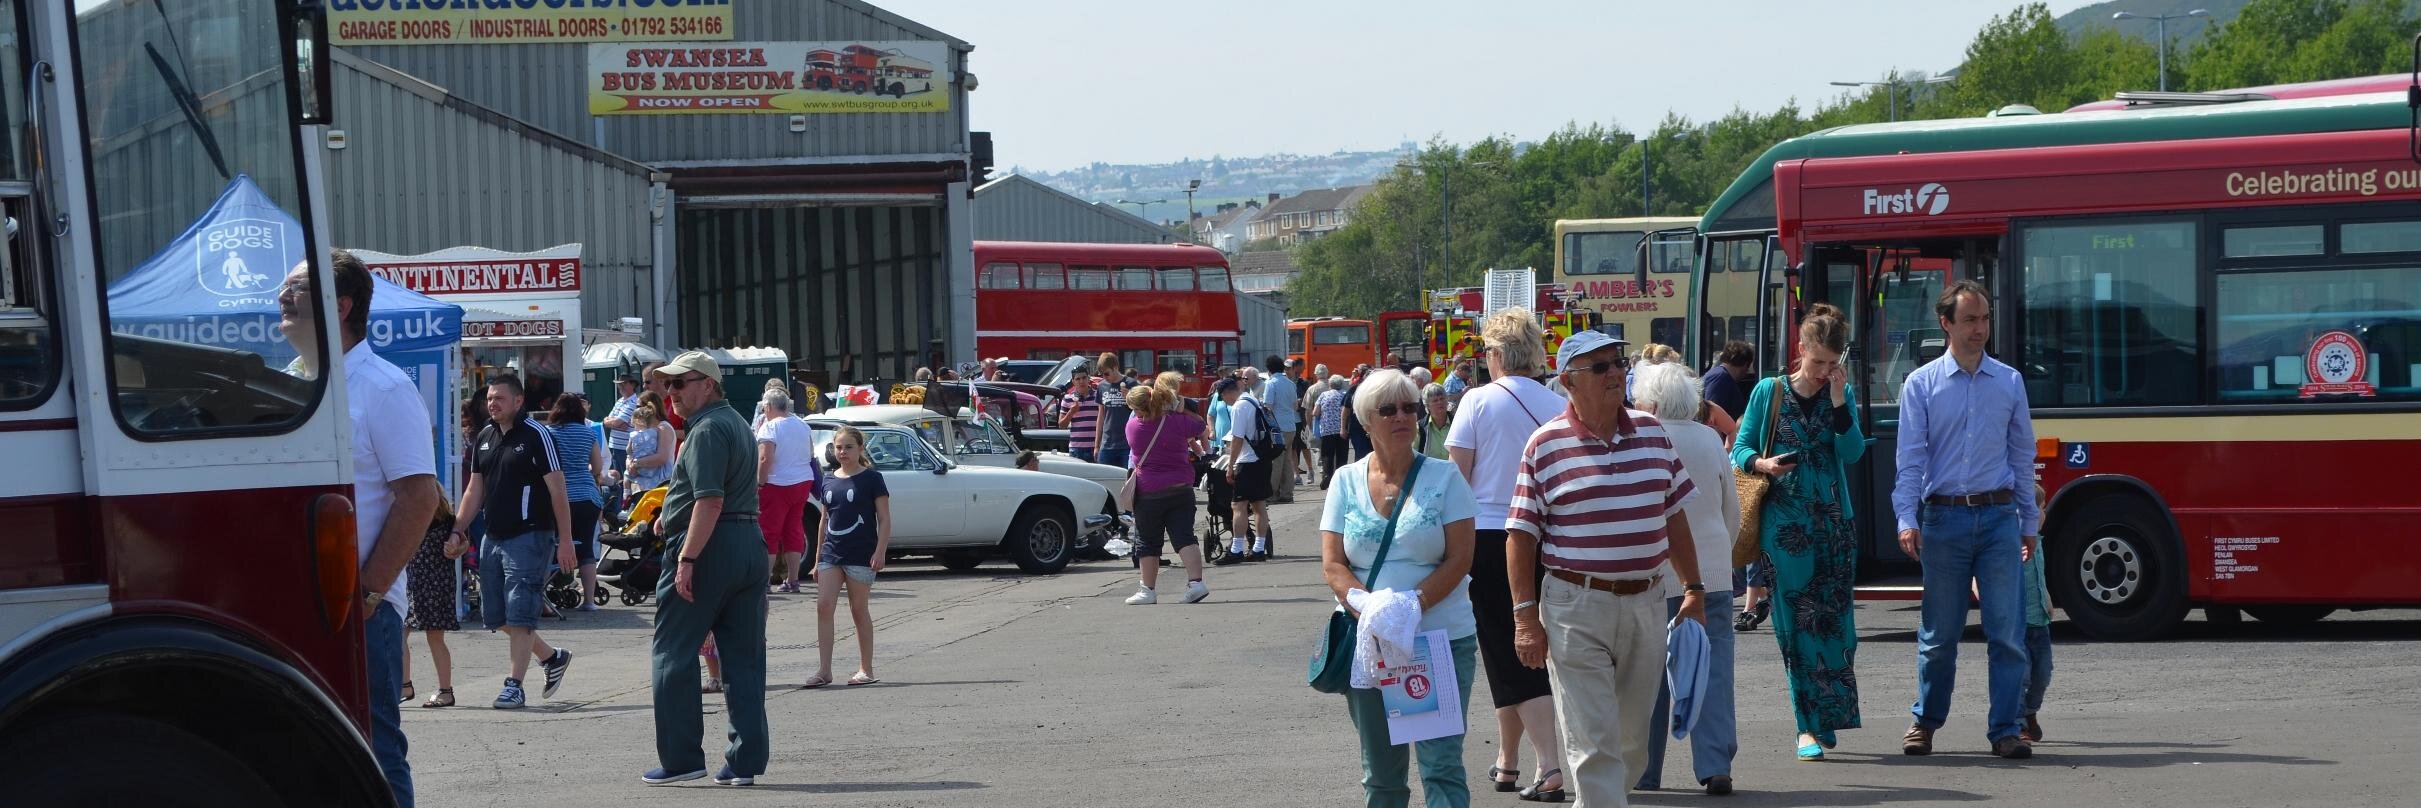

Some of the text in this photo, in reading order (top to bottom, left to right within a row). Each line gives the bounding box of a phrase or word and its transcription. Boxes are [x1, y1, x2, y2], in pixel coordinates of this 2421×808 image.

[339, 20, 396, 40] GARAGE
[401, 20, 451, 39] DOORS
[470, 18, 554, 38] INDUSTRIAL
[558, 18, 608, 37] DOORS
[621, 17, 666, 36] 01792
[670, 16, 722, 35] 534166
[626, 48, 767, 67] SWANSEA
[602, 71, 795, 91] BUS MUSEUM
[638, 97, 760, 107] NOW OPEN
[2226, 167, 2421, 196] Celebrating ou
[1864, 189, 1914, 215] First
[208, 225, 273, 242] GUIDE
[2092, 234, 2136, 249] First
[209, 237, 274, 252] DOGS
[368, 263, 557, 291] NTINENTAL
[218, 297, 274, 307] Cymru
[503, 321, 560, 336] DOGS
[2214, 565, 2228, 573] WEST
